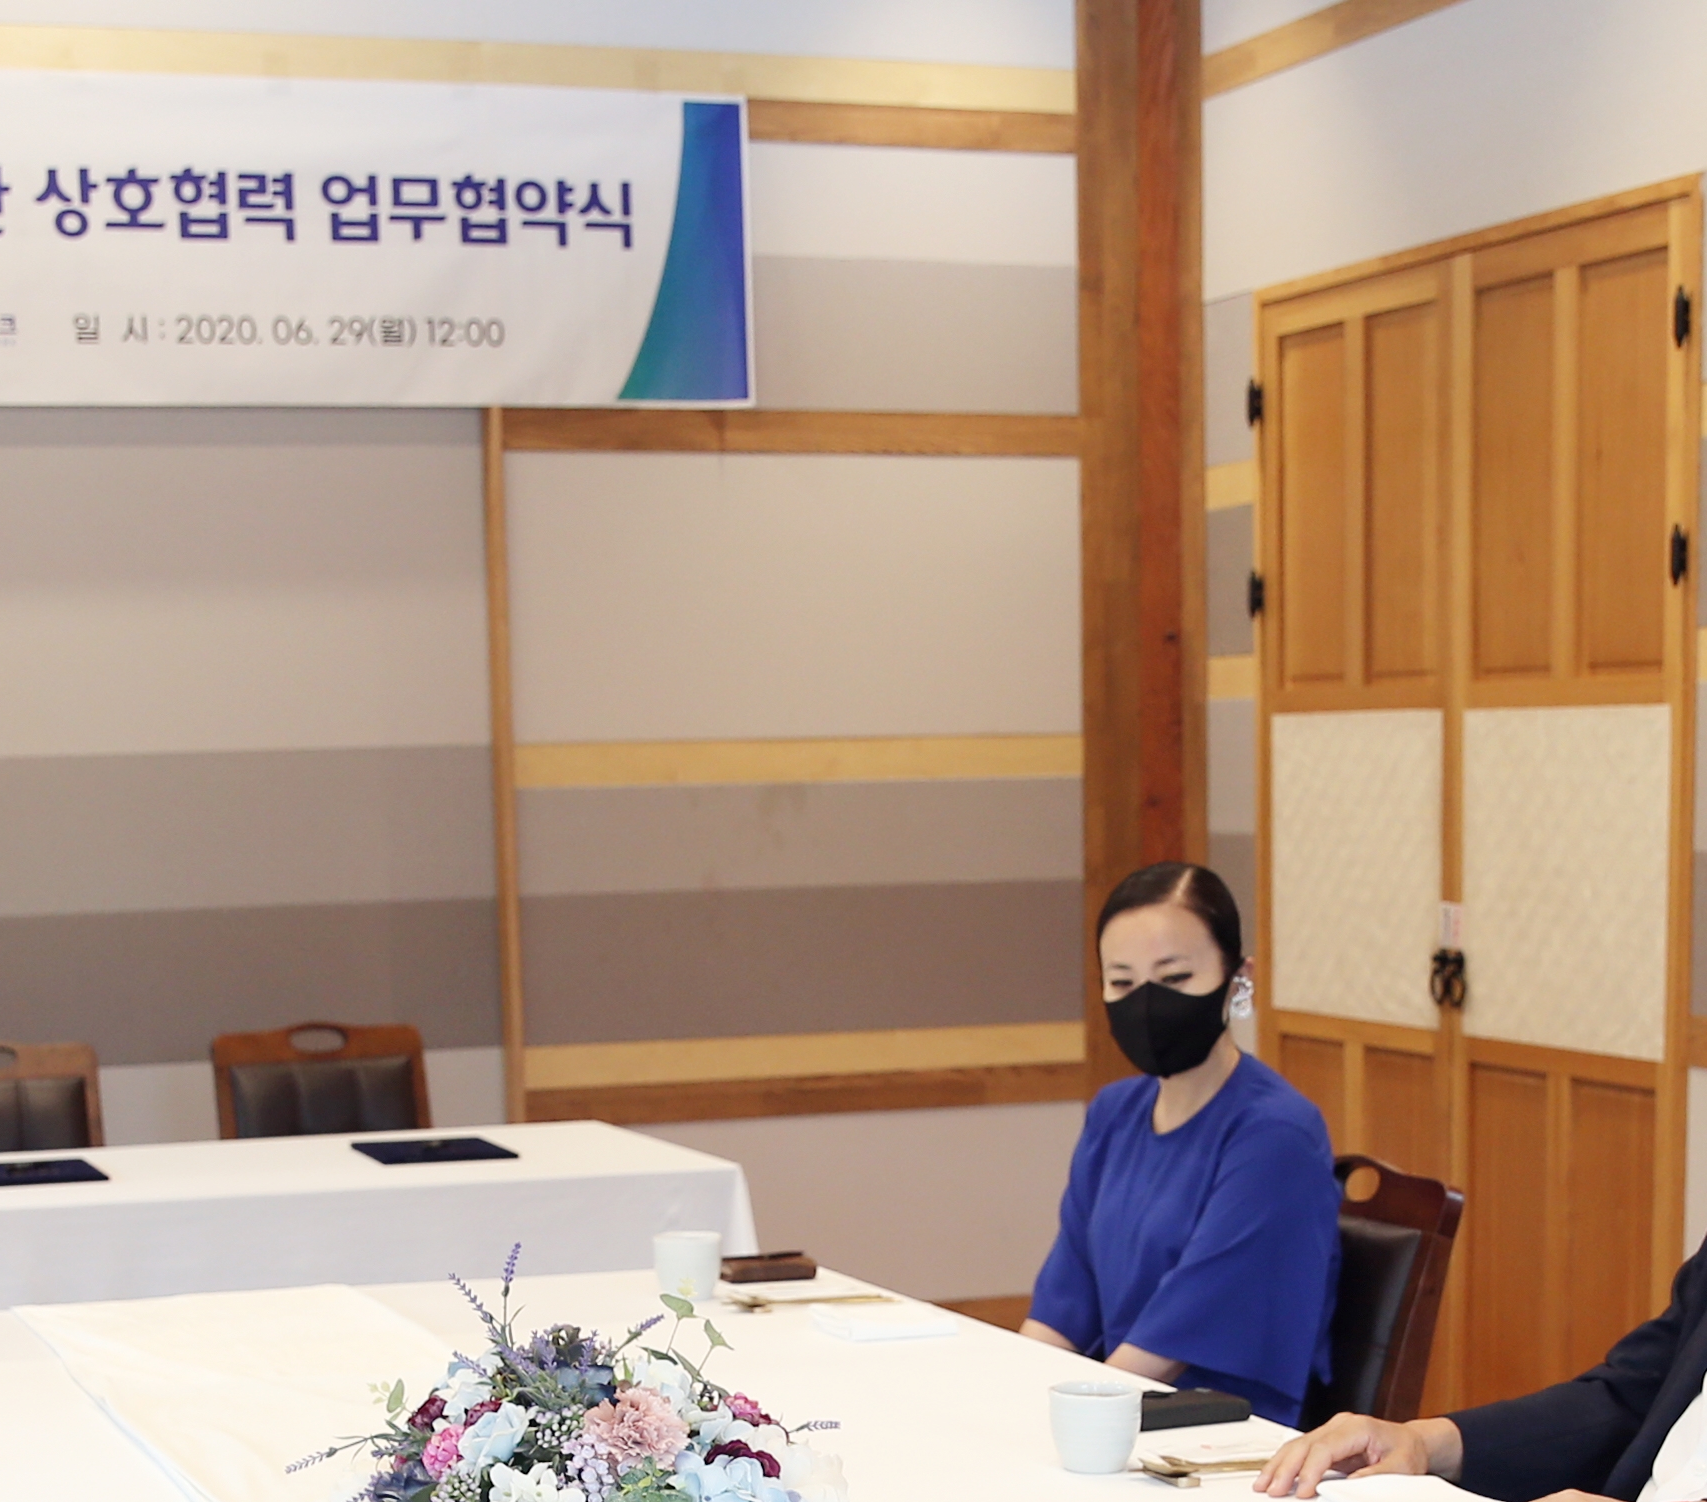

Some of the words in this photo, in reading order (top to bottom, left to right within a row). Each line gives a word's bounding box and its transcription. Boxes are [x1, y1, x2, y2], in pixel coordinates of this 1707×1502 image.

[35, 166, 296, 243] 상호협력
[320, 173, 634, 251] 업무협약식
[175, 314, 263, 346] 2020.
[271, 315, 319, 346] 06.
[328, 314, 419, 349] 29(월)
[422, 315, 507, 349] 12:00
